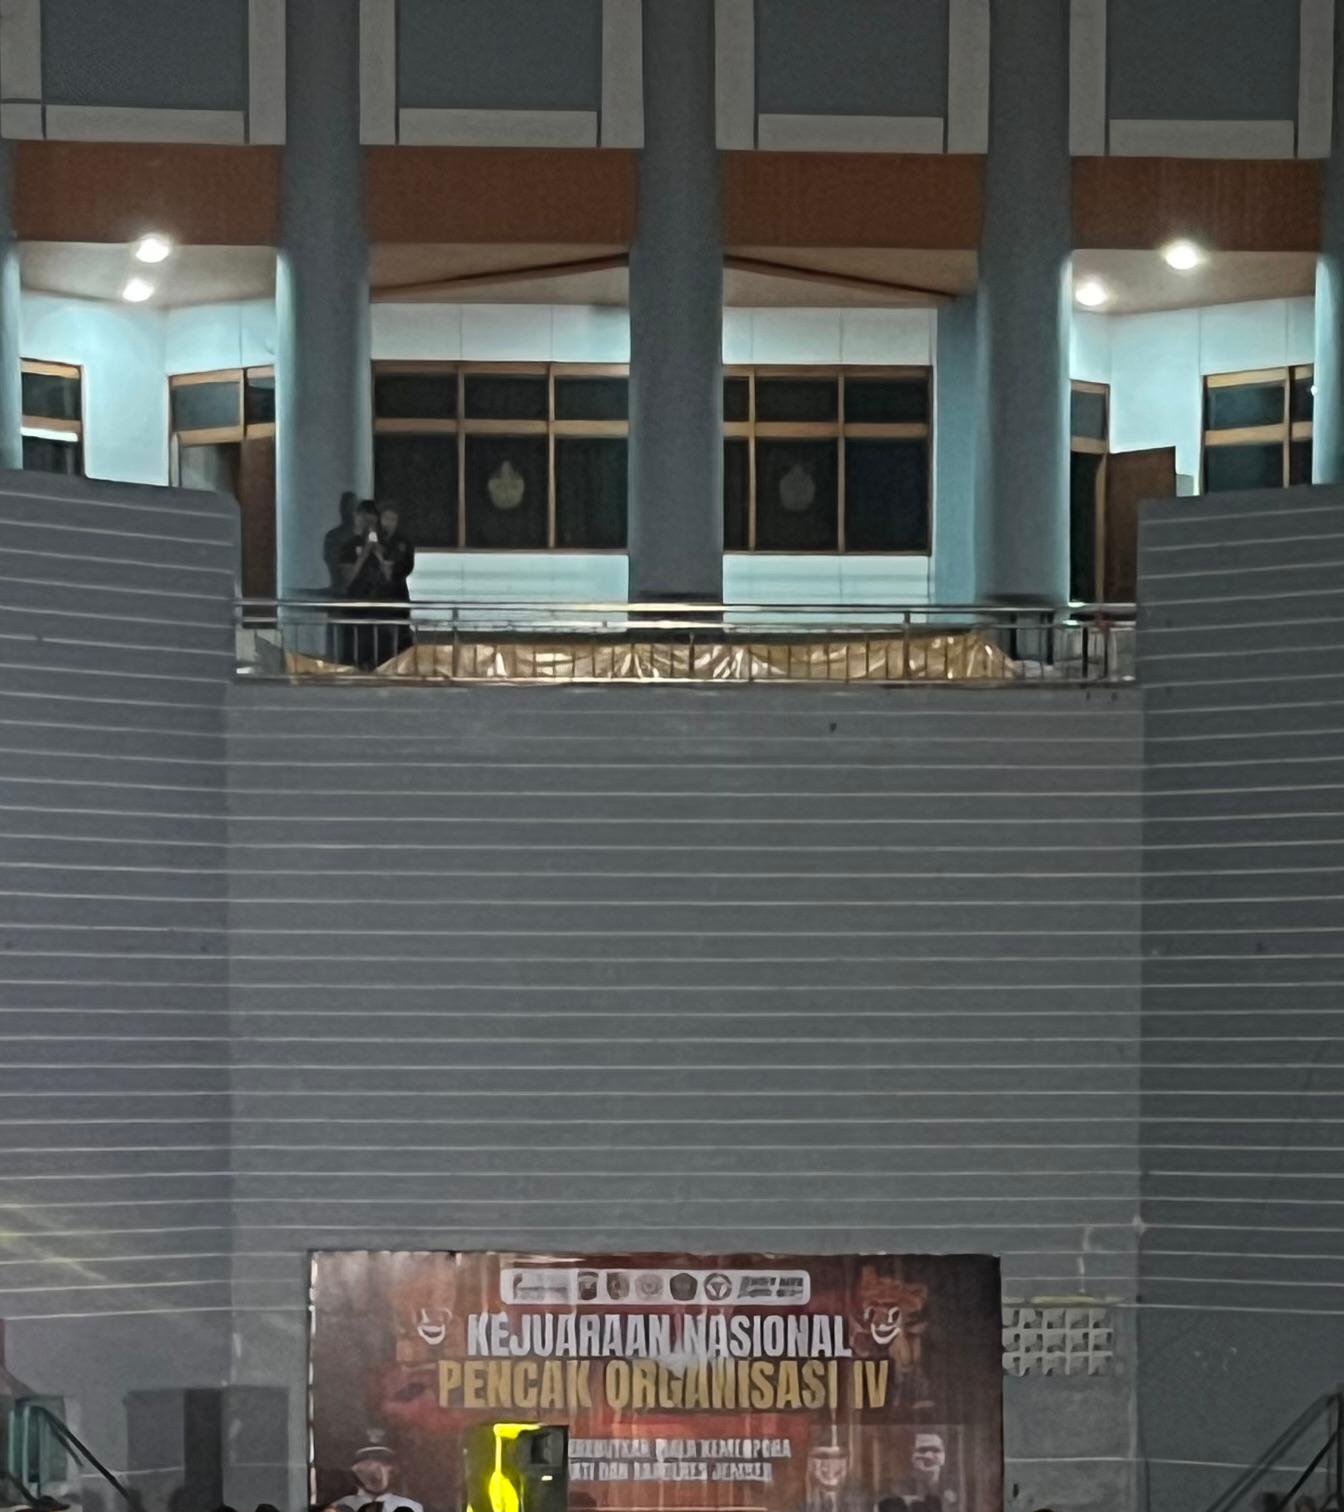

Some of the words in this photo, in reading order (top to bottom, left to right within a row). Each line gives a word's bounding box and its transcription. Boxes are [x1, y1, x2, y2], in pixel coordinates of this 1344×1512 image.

[467, 1312, 674, 1357] KEJUARAAN
[680, 1313, 852, 1357] NASIONAL
[438, 1359, 592, 1408] PENCAK
[605, 1358, 837, 1408] ORGANISASI
[852, 1359, 889, 1408] IV
